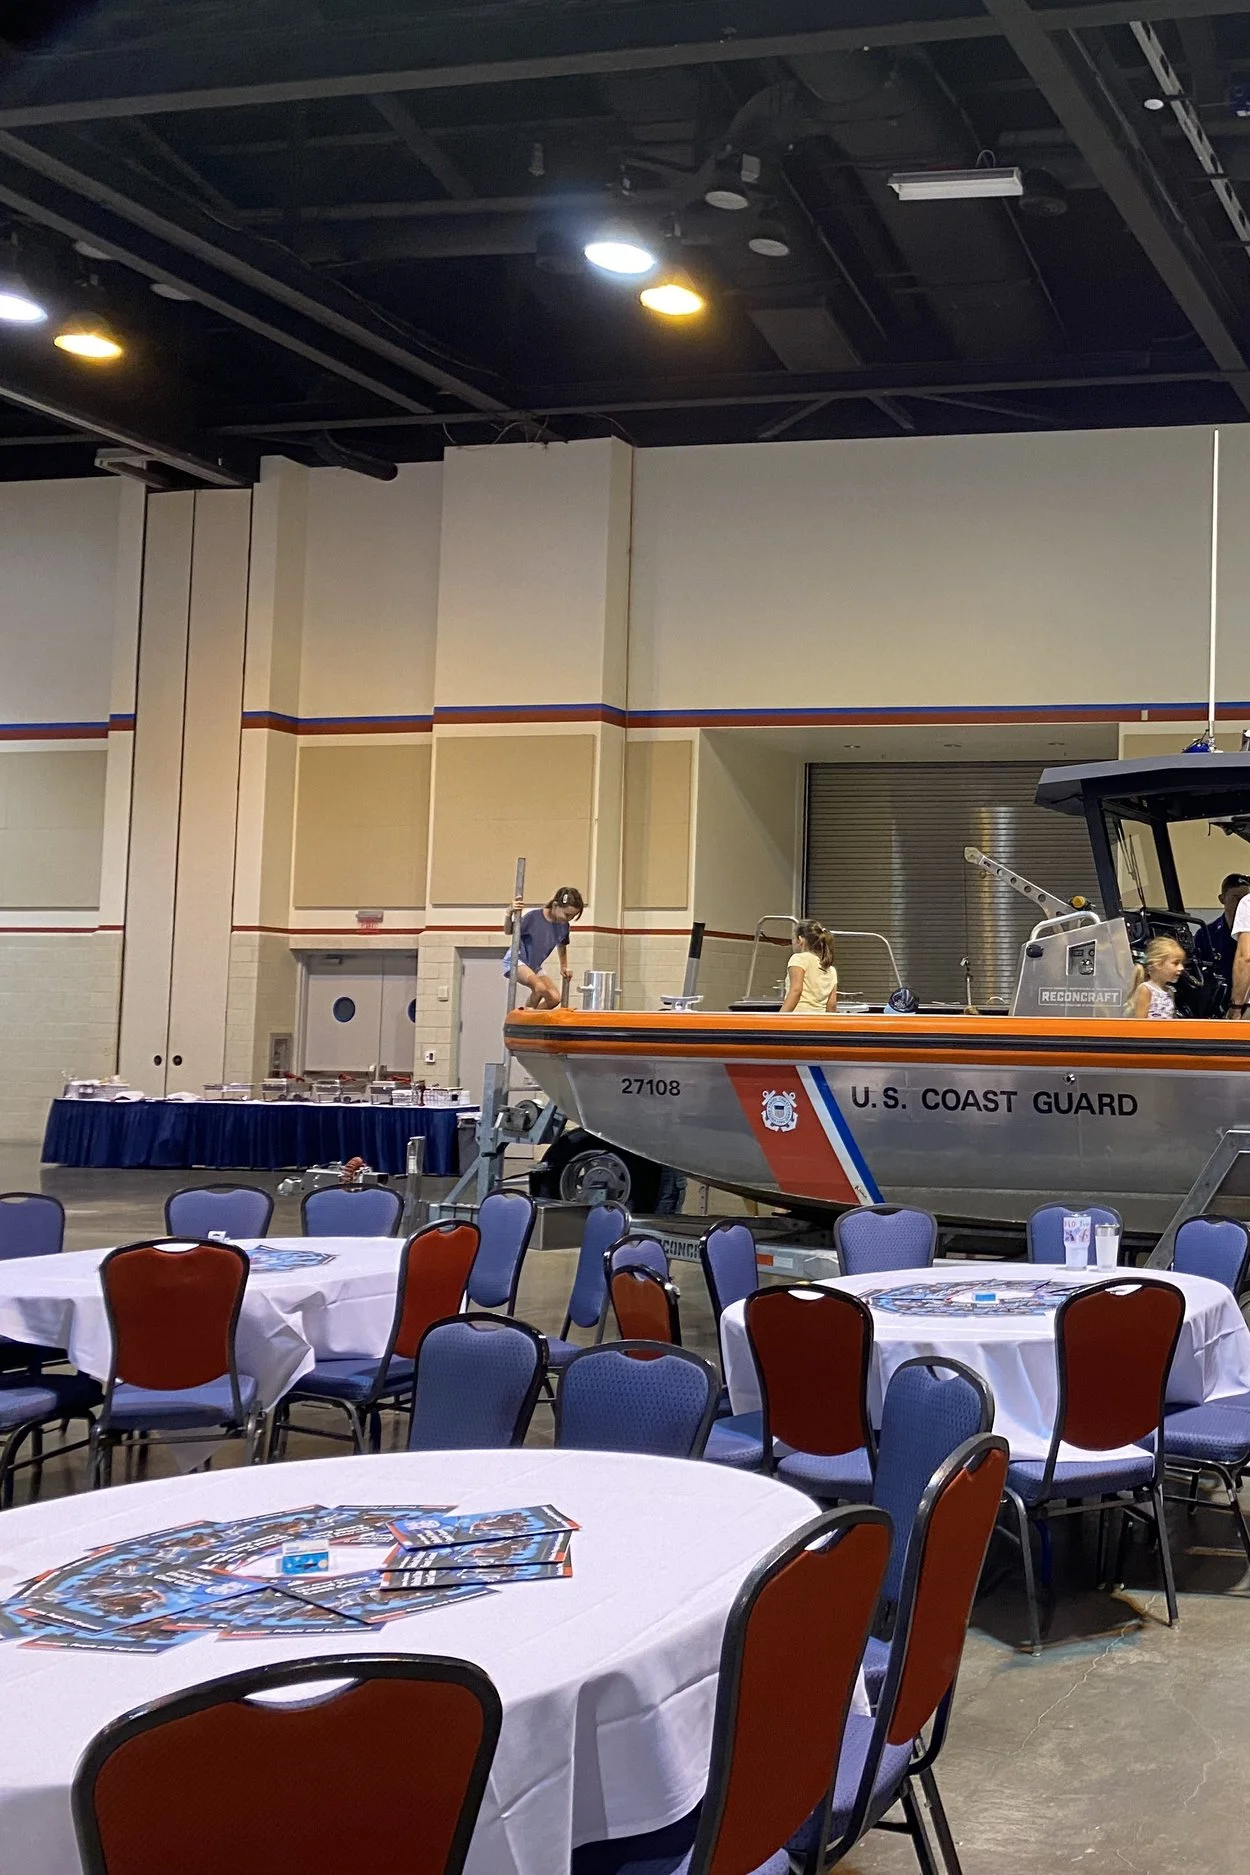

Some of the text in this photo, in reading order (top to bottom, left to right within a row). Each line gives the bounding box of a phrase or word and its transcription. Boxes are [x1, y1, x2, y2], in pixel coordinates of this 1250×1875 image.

[1042, 991, 1119, 1003] RECONCRAFT
[621, 1078, 681, 1097] 27108
[921, 1088, 1018, 1113] COAST
[1032, 1090, 1139, 1117] GUARD
